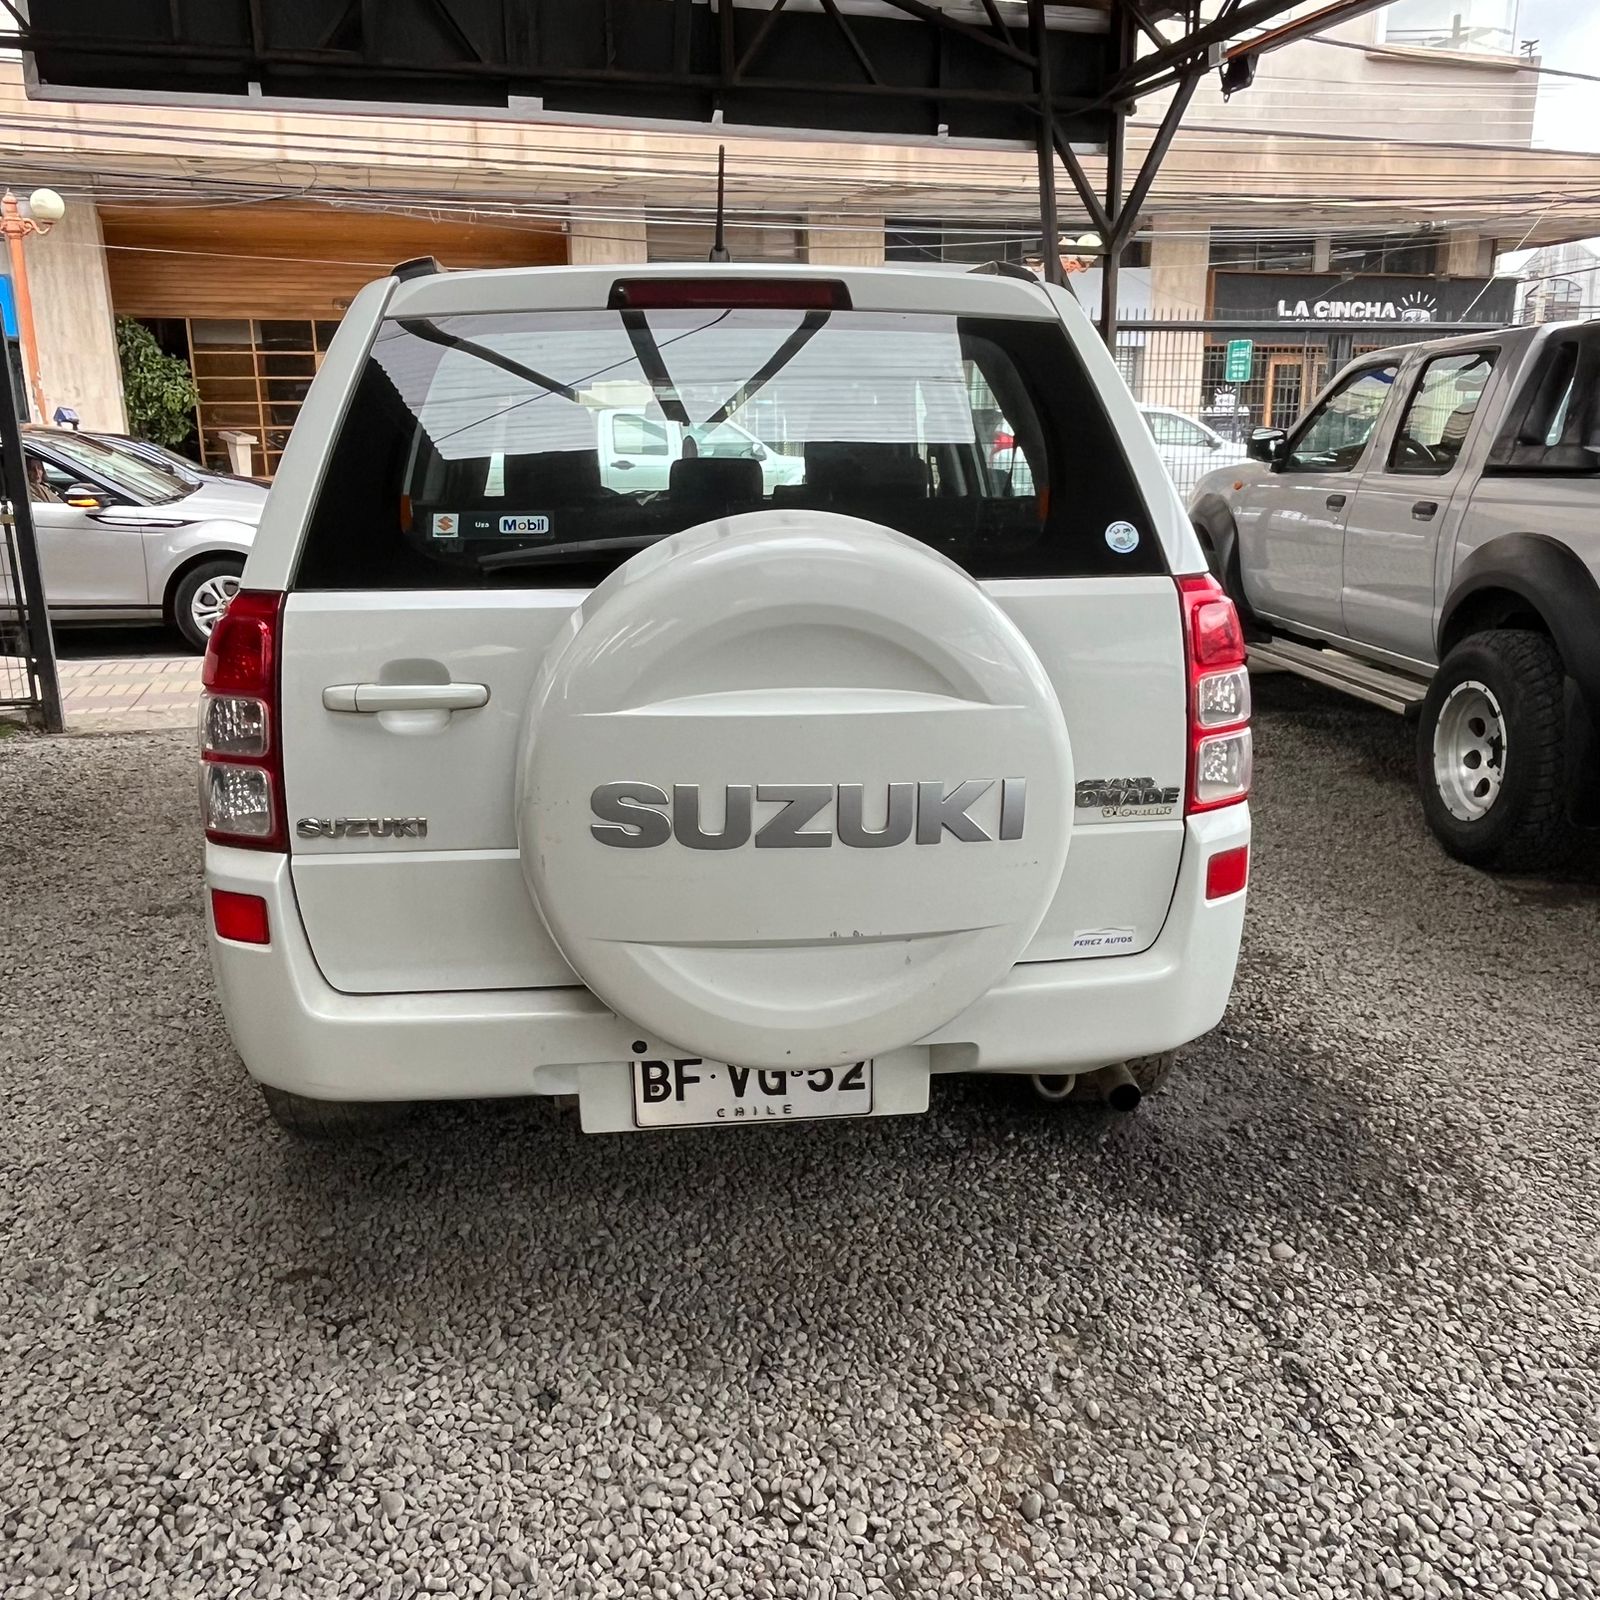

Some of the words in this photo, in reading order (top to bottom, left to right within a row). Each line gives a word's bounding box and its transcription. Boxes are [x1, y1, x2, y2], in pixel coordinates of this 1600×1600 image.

[1277, 300, 1309, 317] LA
[1313, 300, 1396, 319] CINCHA
[503, 519, 545, 531] Mobil
[1075, 787, 1181, 808] OMADE
[590, 777, 1026, 850] SUZUKI
[296, 816, 428, 839] SUZUKI
[1073, 938, 1103, 947] PEREZ
[1104, 936, 1133, 944] AUTOS
[716, 1104, 793, 1118] CHILE
